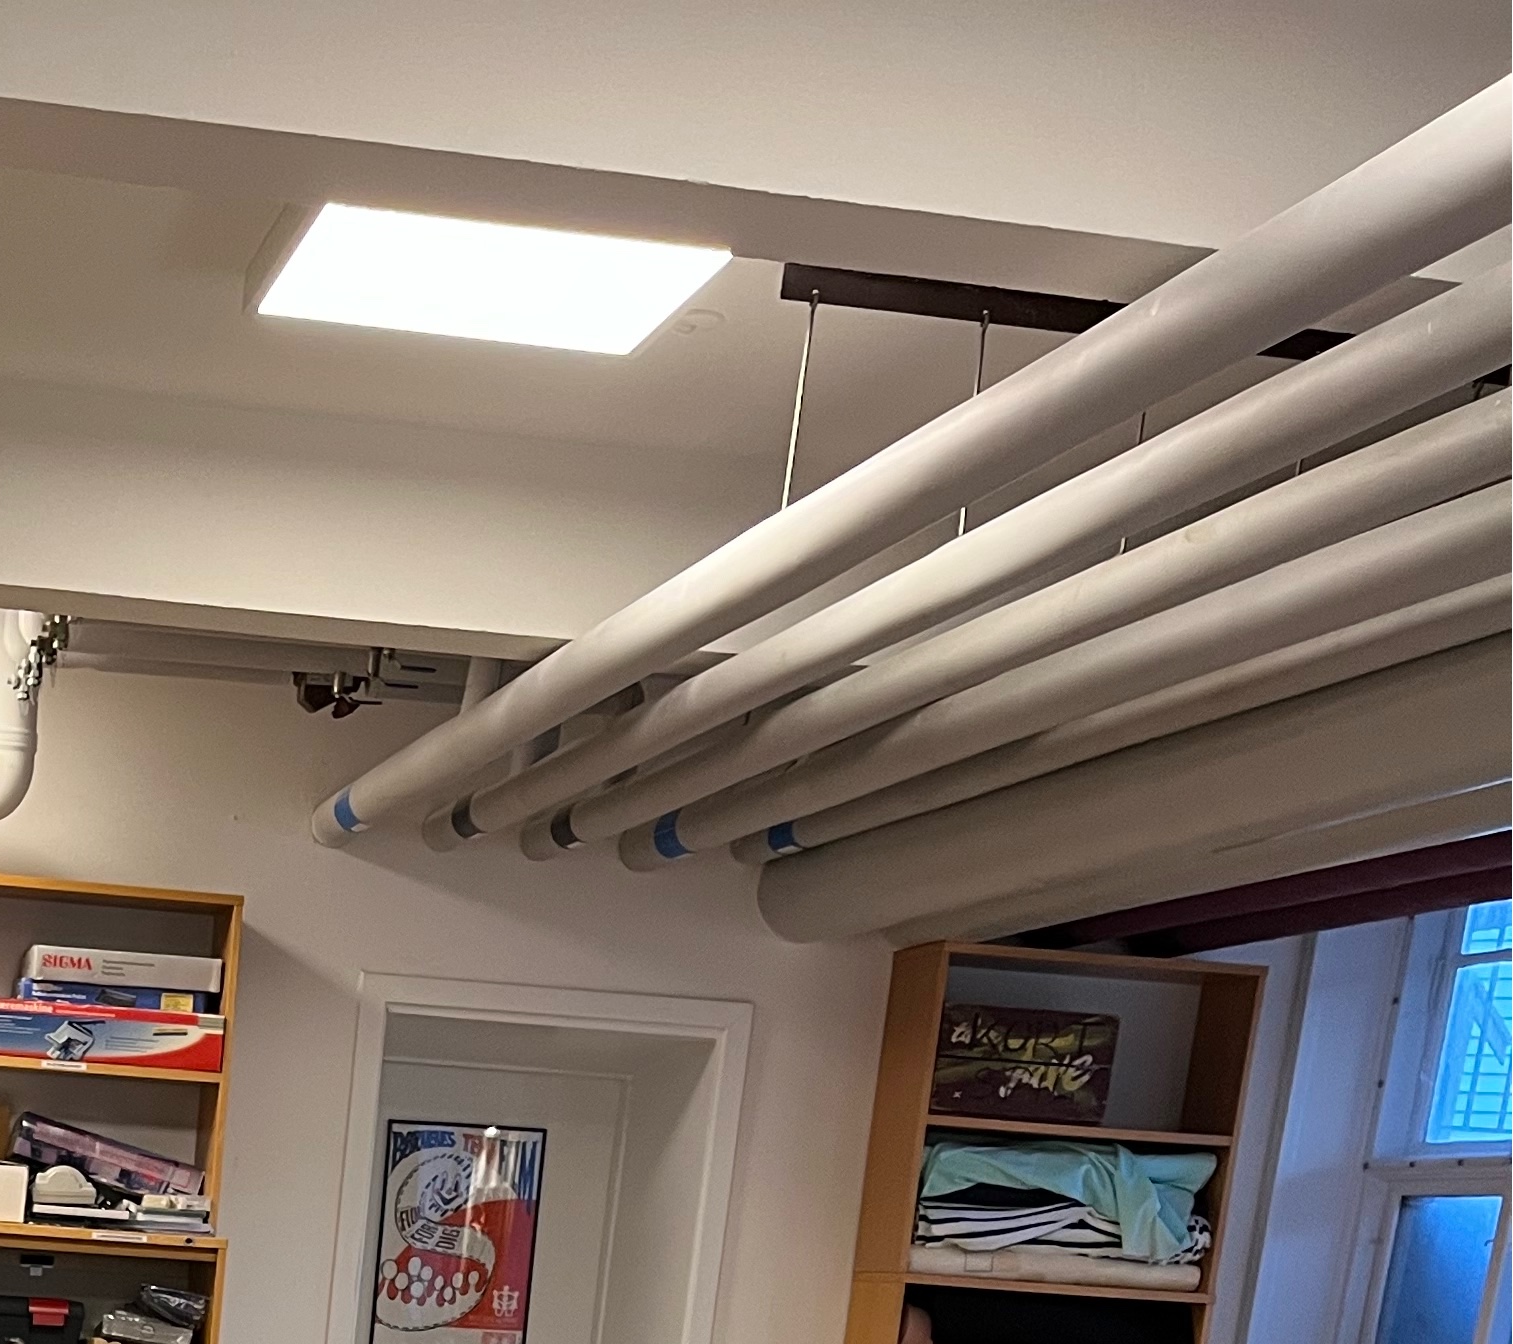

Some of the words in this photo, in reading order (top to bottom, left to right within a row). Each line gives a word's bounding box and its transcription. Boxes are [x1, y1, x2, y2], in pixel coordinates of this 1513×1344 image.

[42, 953, 93, 971] SIGMA
[411, 1222, 438, 1245] FOR
[435, 1226, 461, 1250] DIG
